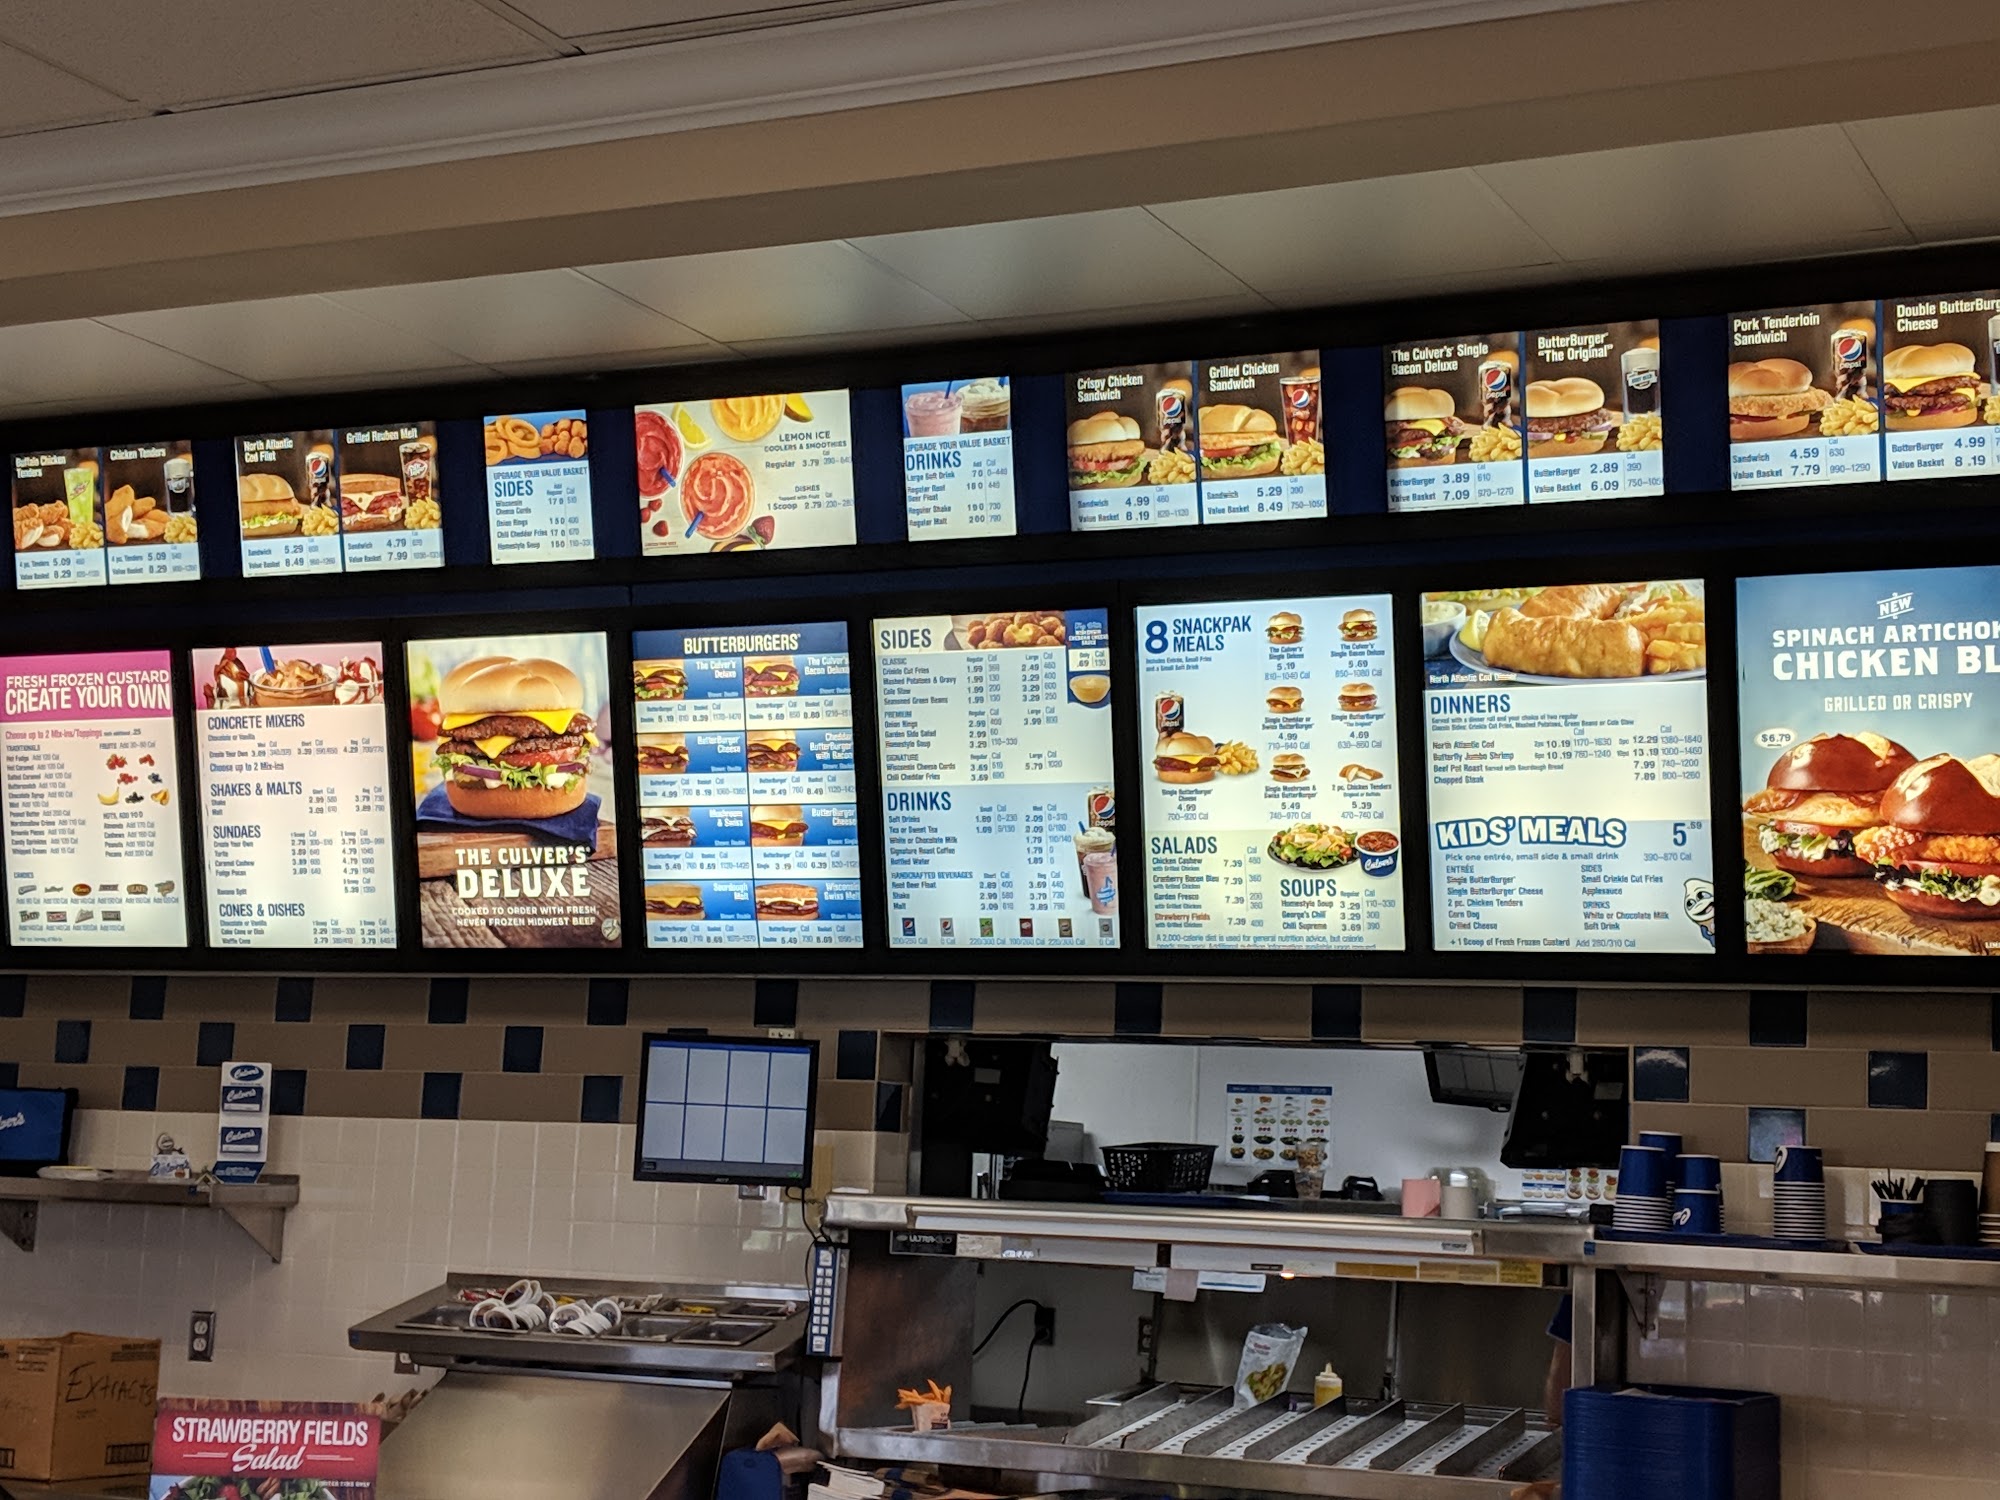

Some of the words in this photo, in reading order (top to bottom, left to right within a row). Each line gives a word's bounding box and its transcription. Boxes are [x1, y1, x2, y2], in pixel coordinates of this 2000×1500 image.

[1897, 302, 1936, 318] Double
[1734, 318, 1759, 332] Pork
[1762, 313, 1820, 328] Tenderloin
[1897, 319, 1938, 333] Cheese
[1538, 333, 1608, 350] ButterBurger
[1734, 331, 1787, 346] Sandwich
[1392, 350, 1410, 363] The
[1413, 346, 1452, 361] Culver's
[1457, 343, 1488, 357] Single
[1209, 366, 1240, 380] Grilled
[1242, 362, 1279, 376] Chicken
[1392, 362, 1422, 376] Bacon
[1424, 360, 1458, 373] Deluxe
[1077, 378, 1106, 394] Crispy
[1108, 375, 1143, 388] Chicken
[1210, 378, 1255, 391] Sandwich
[1077, 390, 1121, 403] Sandwich
[346, 433, 370, 444] Grilled
[372, 431, 399, 442] Reuben
[400, 428, 418, 439] Melt
[779, 433, 812, 442] LEMON
[815, 431, 830, 439] ICE
[243, 441, 264, 450] North
[266, 438, 293, 449] Atlantic
[906, 443, 937, 451] UPGRADE
[940, 441, 957, 449] YOUR
[959, 440, 981, 449] VALUE
[984, 437, 1010, 445] BASKET
[1892, 442, 1944, 453] ButterBurger
[1954, 438, 1985, 448] 4.99
[906, 451, 961, 471] DRINKS
[1732, 453, 1769, 464] Sandwich
[1790, 448, 1819, 459] 4.59
[1892, 460, 1915, 470] Value
[1917, 458, 1945, 468] Basket
[1955, 455, 1986, 466] 8.19
[765, 460, 795, 469] Regular
[802, 459, 819, 467] 3.79
[1590, 463, 1618, 474] 2.89
[1442, 473, 1470, 484] 3.89
[494, 480, 533, 498] SIDES
[1207, 490, 1238, 500] Sandwich
[1257, 487, 1282, 497] 5.29
[1534, 483, 1555, 494] Value
[1557, 481, 1582, 492] Basket
[1591, 481, 1619, 491] 6.09
[1126, 497, 1150, 507] 4.99
[1443, 490, 1470, 501] 7.09
[773, 502, 797, 512] Scoop
[804, 502, 821, 510] 2.79
[387, 539, 406, 548] 4.79
[1879, 596, 1911, 616] NEW
[881, 628, 932, 649] SIDES
[1145, 620, 1168, 654] 8
[1173, 615, 1251, 635] SNACKPAK
[1773, 626, 1874, 648] SPINACH
[684, 634, 799, 654] BUTTERBURGERS
[1173, 634, 1225, 653] MEALS
[1772, 647, 1938, 681] CHICKEN
[6, 675, 47, 689] FRESH
[50, 673, 105, 687] FROZEN
[107, 670, 169, 684] CUSTARD
[5, 687, 71, 715] CREATE
[76, 685, 124, 708] YOUR
[127, 684, 171, 710] OWN
[1431, 694, 1510, 715] DINNERS
[1824, 695, 1887, 712] GRILLED
[1893, 695, 1911, 711] OR
[1918, 693, 1973, 709] CRISPY
[208, 715, 262, 730] CONCRETE
[266, 714, 305, 728] MIXERS
[1433, 741, 1452, 749] North
[1454, 741, 1480, 749] Atlantic
[1481, 740, 1494, 749] Cod
[1546, 740, 1571, 749] 10.19
[1633, 735, 1658, 744] 12.29
[1761, 733, 1791, 743] $6.79
[209, 763, 233, 772] Choose
[235, 764, 243, 772] up
[245, 763, 252, 771] to
[254, 762, 258, 770] 2
[260, 762, 284, 771] Mix-ins
[1433, 764, 1449, 772] Beef
[1451, 764, 1462, 772] Pot
[1464, 764, 1483, 772] Roast
[1634, 761, 1655, 769] 7.99
[211, 783, 251, 796] SHAKES
[255, 784, 263, 795] &
[267, 782, 302, 795] MALTS
[887, 792, 952, 811] DRINKS
[213, 825, 261, 839] SUNDAES
[1436, 817, 1516, 849] KIDS'
[1519, 816, 1626, 848] MEALS
[1151, 837, 1217, 854] SALADS
[455, 849, 491, 865] THE
[498, 847, 587, 865] CULVER'S
[1484, 853, 1513, 862] entrée,
[1516, 853, 1539, 861] small
[456, 867, 591, 898] DELUXE
[1581, 875, 1601, 883] Small
[1603, 875, 1628, 883] Crinkle
[1631, 875, 1644, 883] Cut
[1646, 875, 1663, 883] Fries
[1280, 879, 1337, 897] SOUPS
[219, 904, 253, 917] CONES
[256, 904, 264, 916] &
[268, 903, 305, 916] DISHES
[452, 906, 489, 916] COOKED
[492, 906, 503, 915] TO
[507, 906, 537, 915] ORDER
[540, 906, 564, 915] WITH
[566, 905, 600, 915] FRESH,
[457, 918, 486, 927] NEVER
[489, 918, 525, 926] FROZEN
[527, 917, 569, 926] MIDWEST
[572, 917, 596, 926] BEEF
[1155, 914, 1186, 922] Strawberry
[1188, 913, 1210, 921] Fields
[1228, 917, 1246, 926] 7.39
[1282, 922, 1296, 930] Chili
[1299, 923, 1327, 931] Supreme
[1341, 923, 1361, 932] 3.69
[172, 1417, 301, 1445] STRAWBERRY
[304, 1420, 369, 1447] FIELDS
[232, 1445, 304, 1472] Salad
